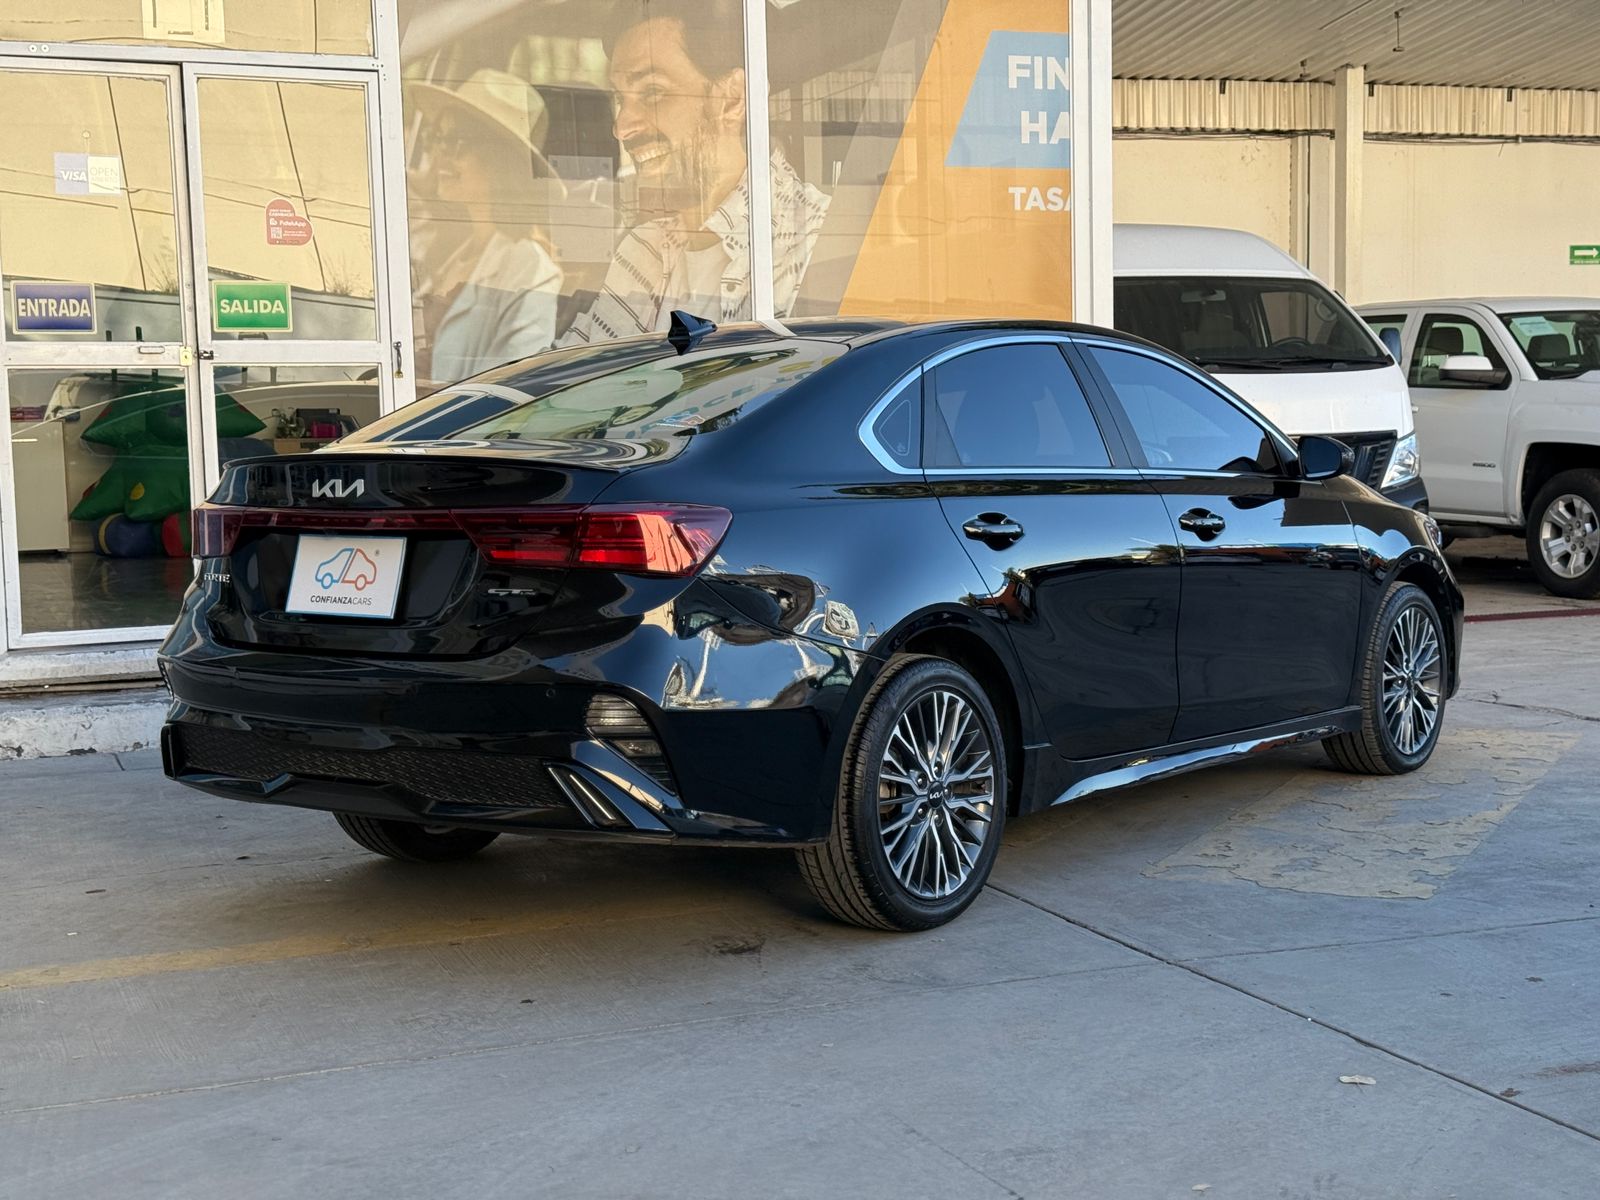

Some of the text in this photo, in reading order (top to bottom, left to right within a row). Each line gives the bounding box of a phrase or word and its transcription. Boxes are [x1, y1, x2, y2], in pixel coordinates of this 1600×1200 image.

[1007, 55, 1070, 90] FIN
[60, 170, 87, 182] VISA
[90, 167, 118, 177] OPEN
[1008, 186, 1071, 211] TAS
[17, 298, 91, 317] ENTRADA
[220, 299, 285, 315] SALIDA
[312, 479, 365, 498] KIA
[310, 594, 372, 606] CONFIANZACARS
